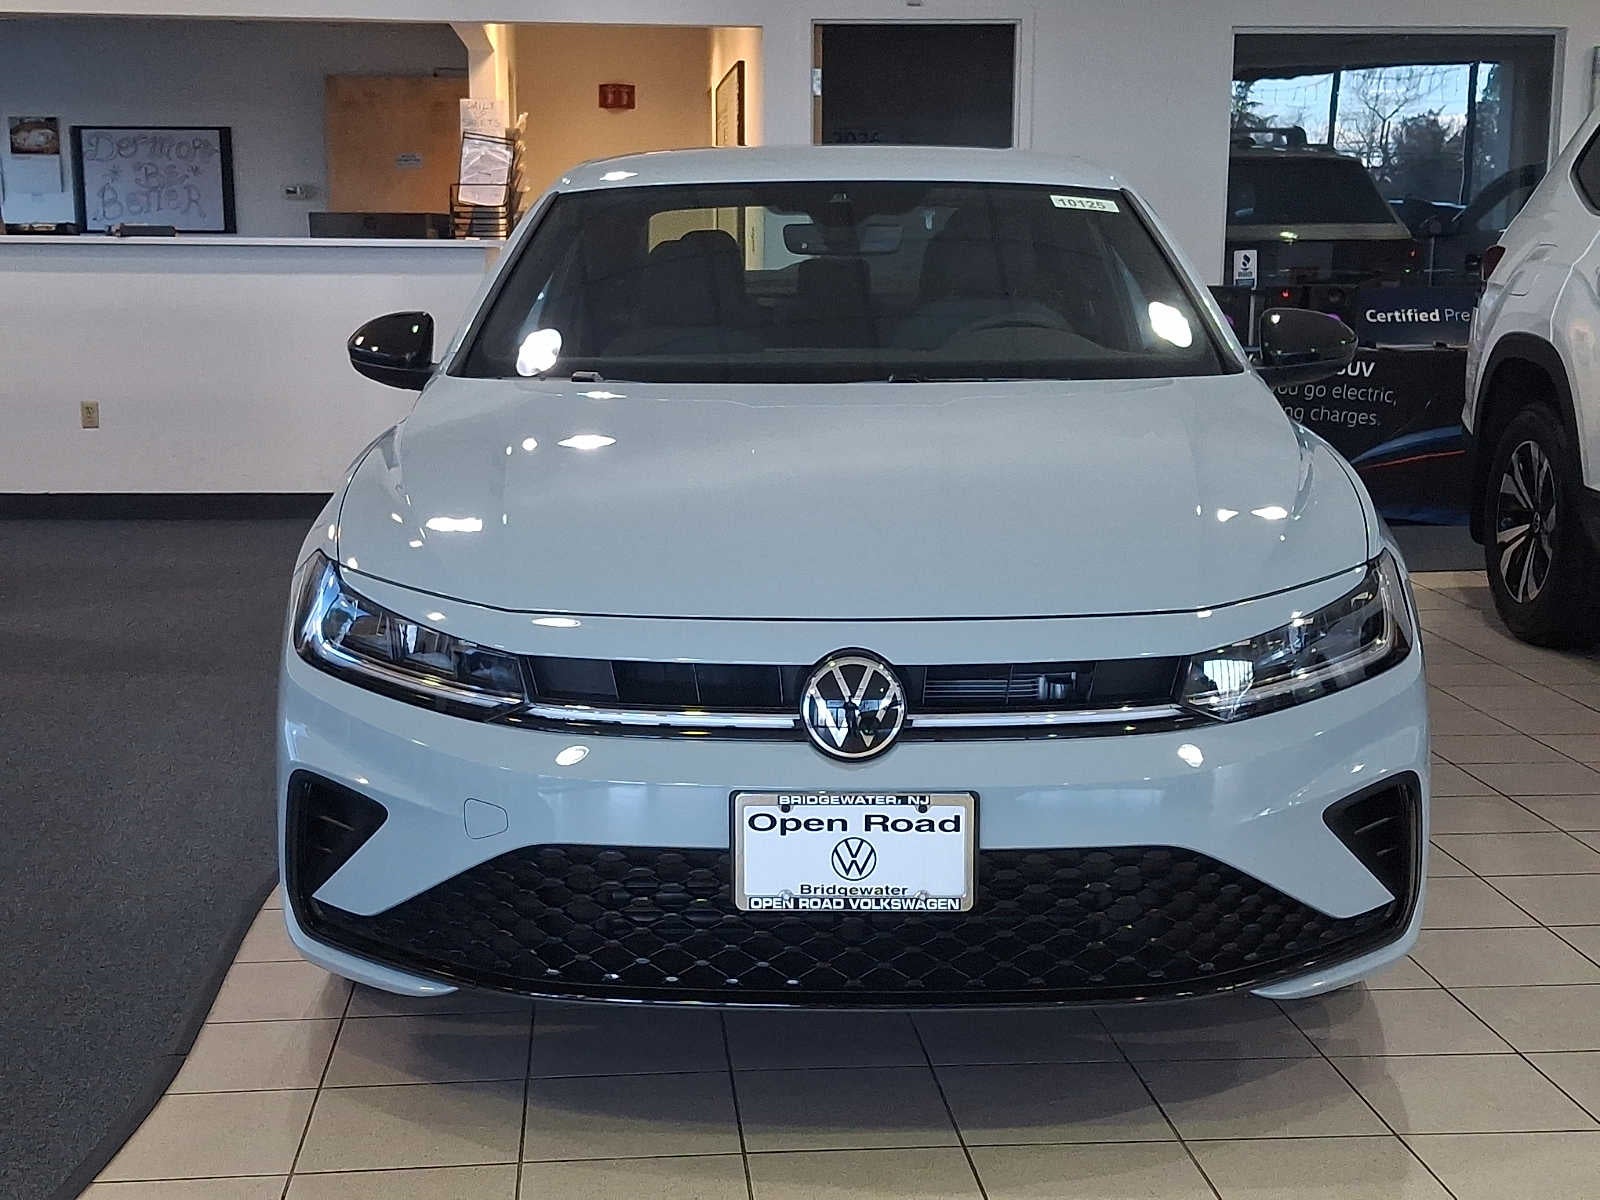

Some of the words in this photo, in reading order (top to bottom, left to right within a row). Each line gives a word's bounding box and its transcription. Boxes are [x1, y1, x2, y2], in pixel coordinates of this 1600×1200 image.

[1058, 197, 1106, 210] 10125
[1365, 308, 1441, 323] Certified
[1337, 360, 1376, 378] UV
[1304, 383, 1326, 400] go
[1331, 383, 1398, 407] electric,
[907, 795, 930, 805] NJ
[748, 812, 848, 836] Open
[864, 814, 961, 833] Road
[800, 884, 908, 896] Bridgewater
[750, 897, 794, 910] OPEN
[799, 897, 844, 910] ROAD
[849, 897, 960, 910] VOLKSWAGEN
